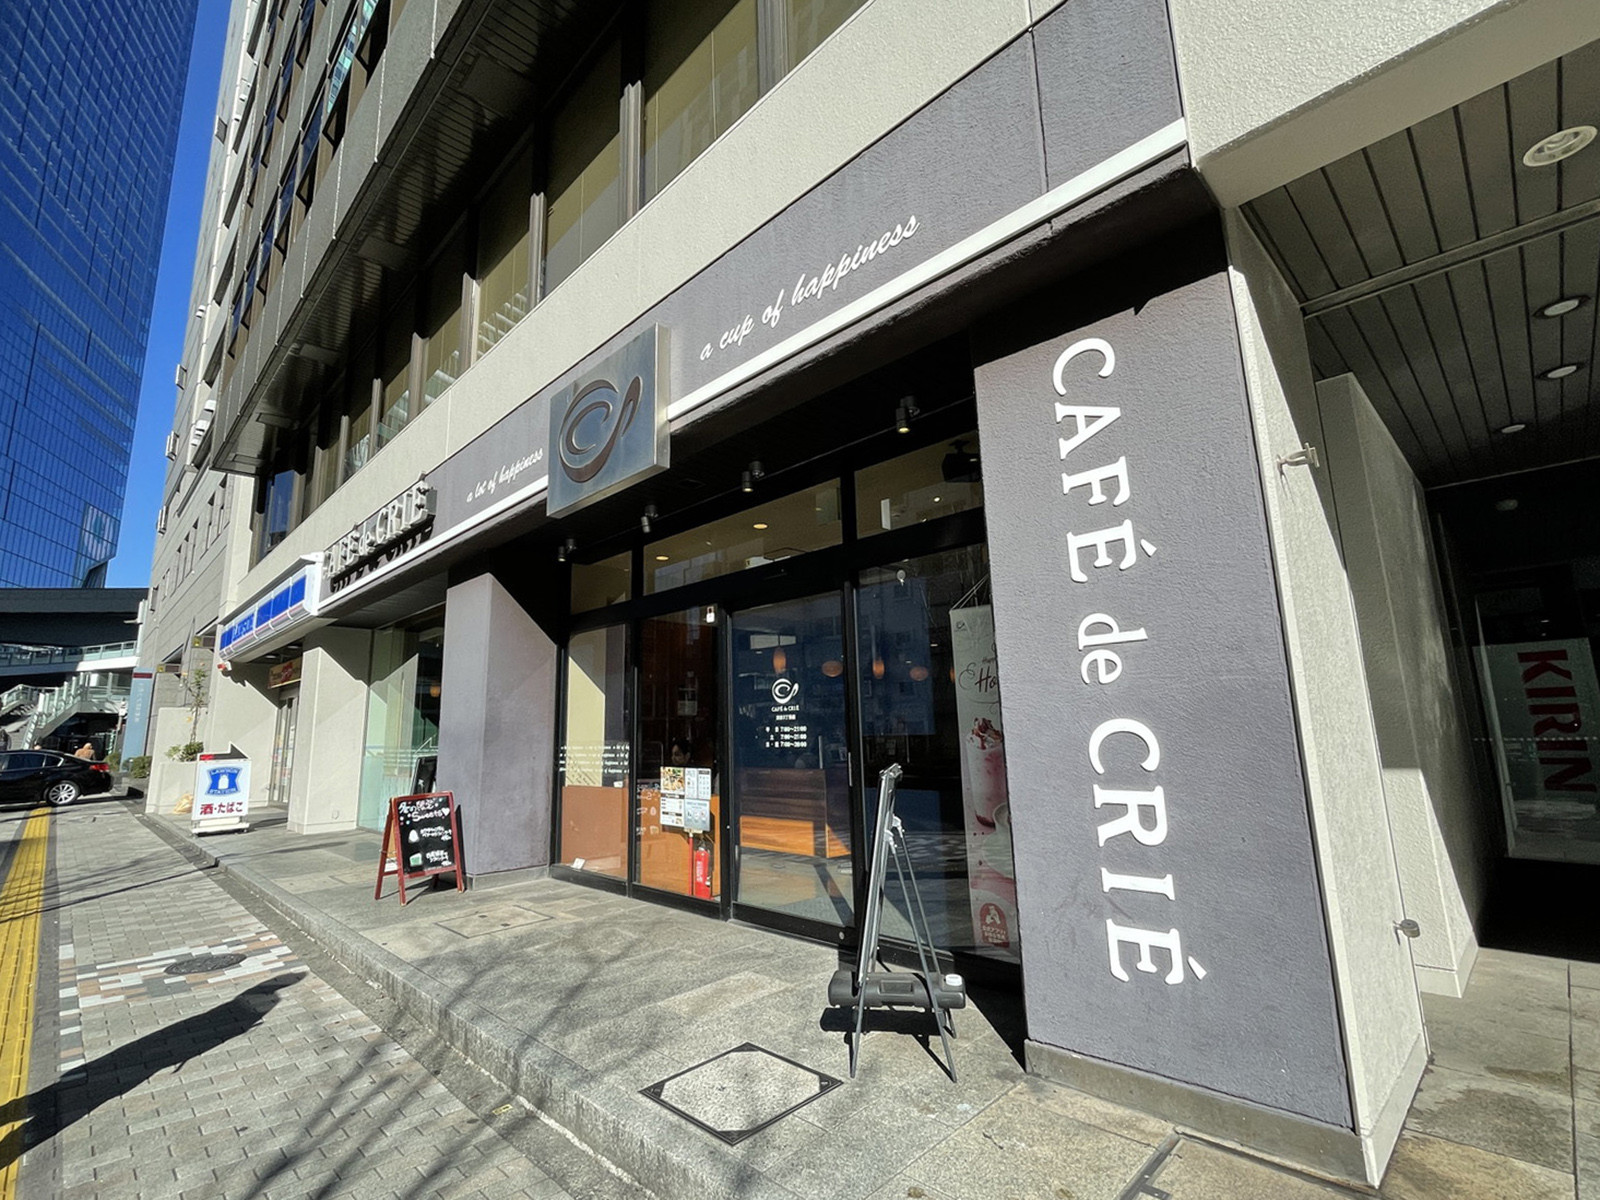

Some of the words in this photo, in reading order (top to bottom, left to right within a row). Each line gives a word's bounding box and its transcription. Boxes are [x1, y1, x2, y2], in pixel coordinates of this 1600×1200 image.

[699, 341, 713, 361] a
[718, 314, 756, 347] cup
[761, 288, 785, 328] of
[791, 214, 921, 306] happiness
[466, 490, 474, 503] a
[474, 480, 487, 499] lot
[487, 470, 498, 495] of
[498, 447, 544, 484] happiness
[1052, 337, 1157, 583] CAFÉ
[1077, 612, 1148, 685] de
[1516, 649, 1598, 793] KIRIN
[199, 801, 244, 816] 酒・たばこ
[1088, 717, 1208, 986] CRIÉ
